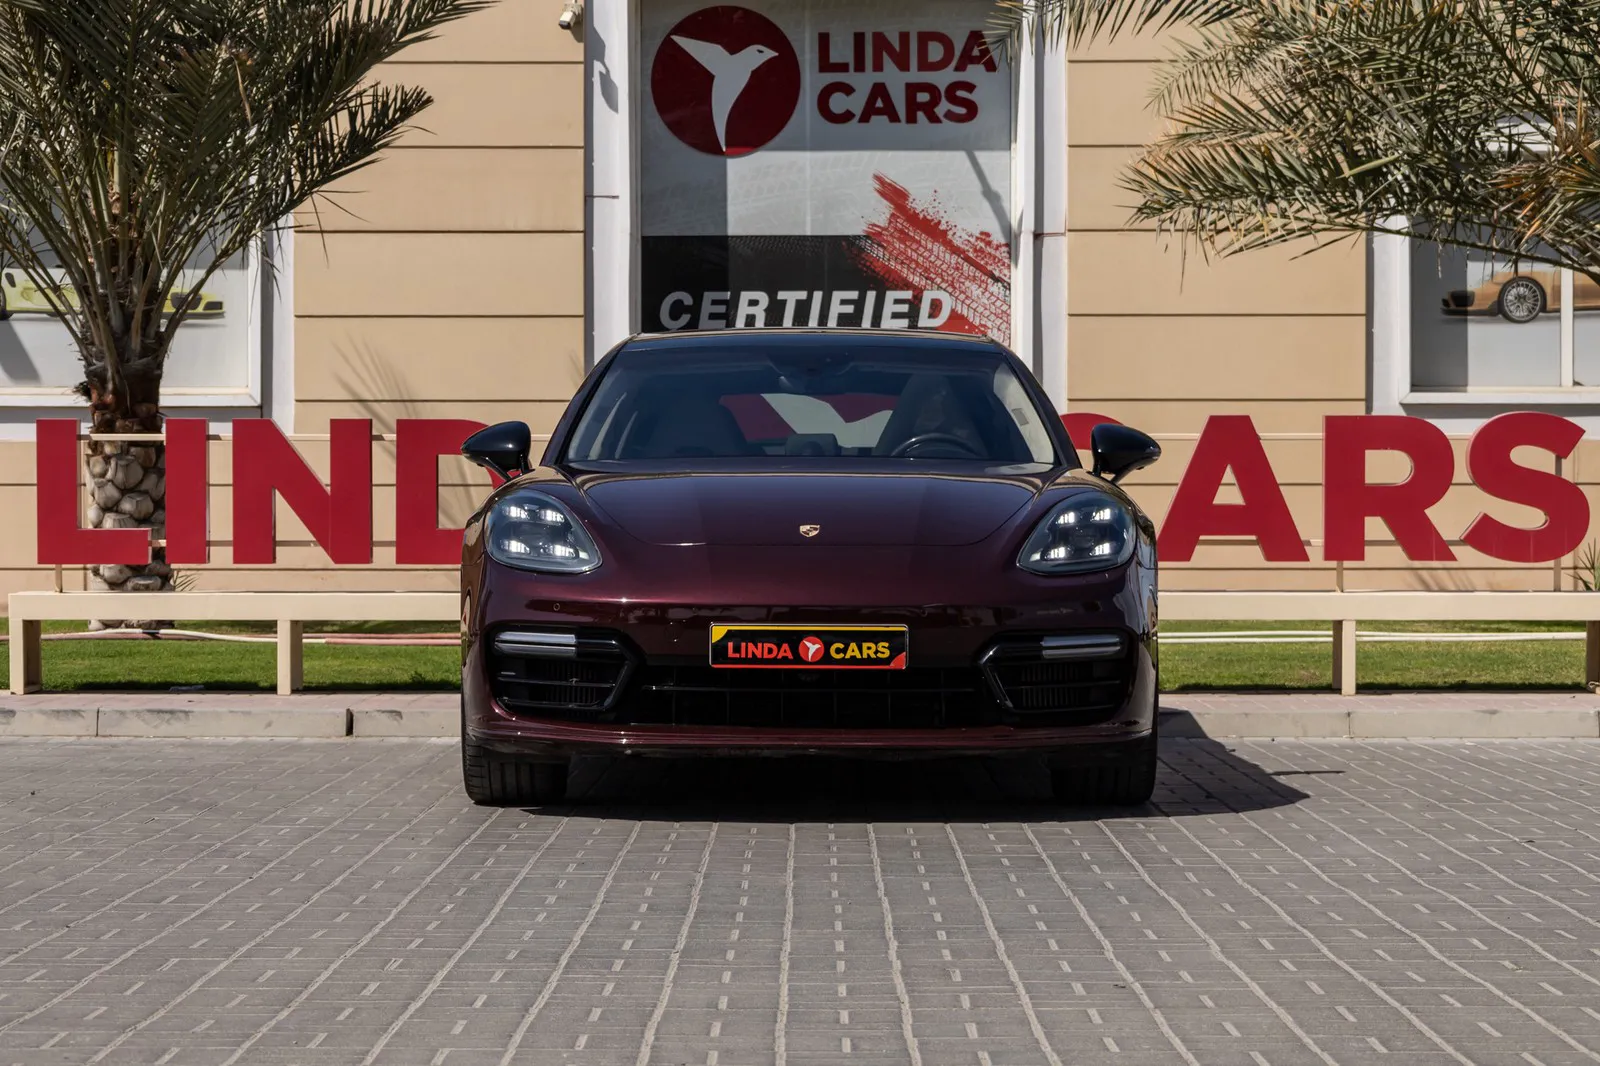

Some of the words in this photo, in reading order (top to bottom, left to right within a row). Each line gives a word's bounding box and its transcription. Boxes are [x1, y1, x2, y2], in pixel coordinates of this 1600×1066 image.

[817, 30, 996, 73] LINDA
[816, 80, 979, 124] CARS
[659, 290, 953, 329] CERTIFIED
[36, 418, 523, 565] LIND
[1060, 411, 1590, 563] ARS
[727, 641, 793, 659] LINDA
[829, 641, 890, 659] CARS
